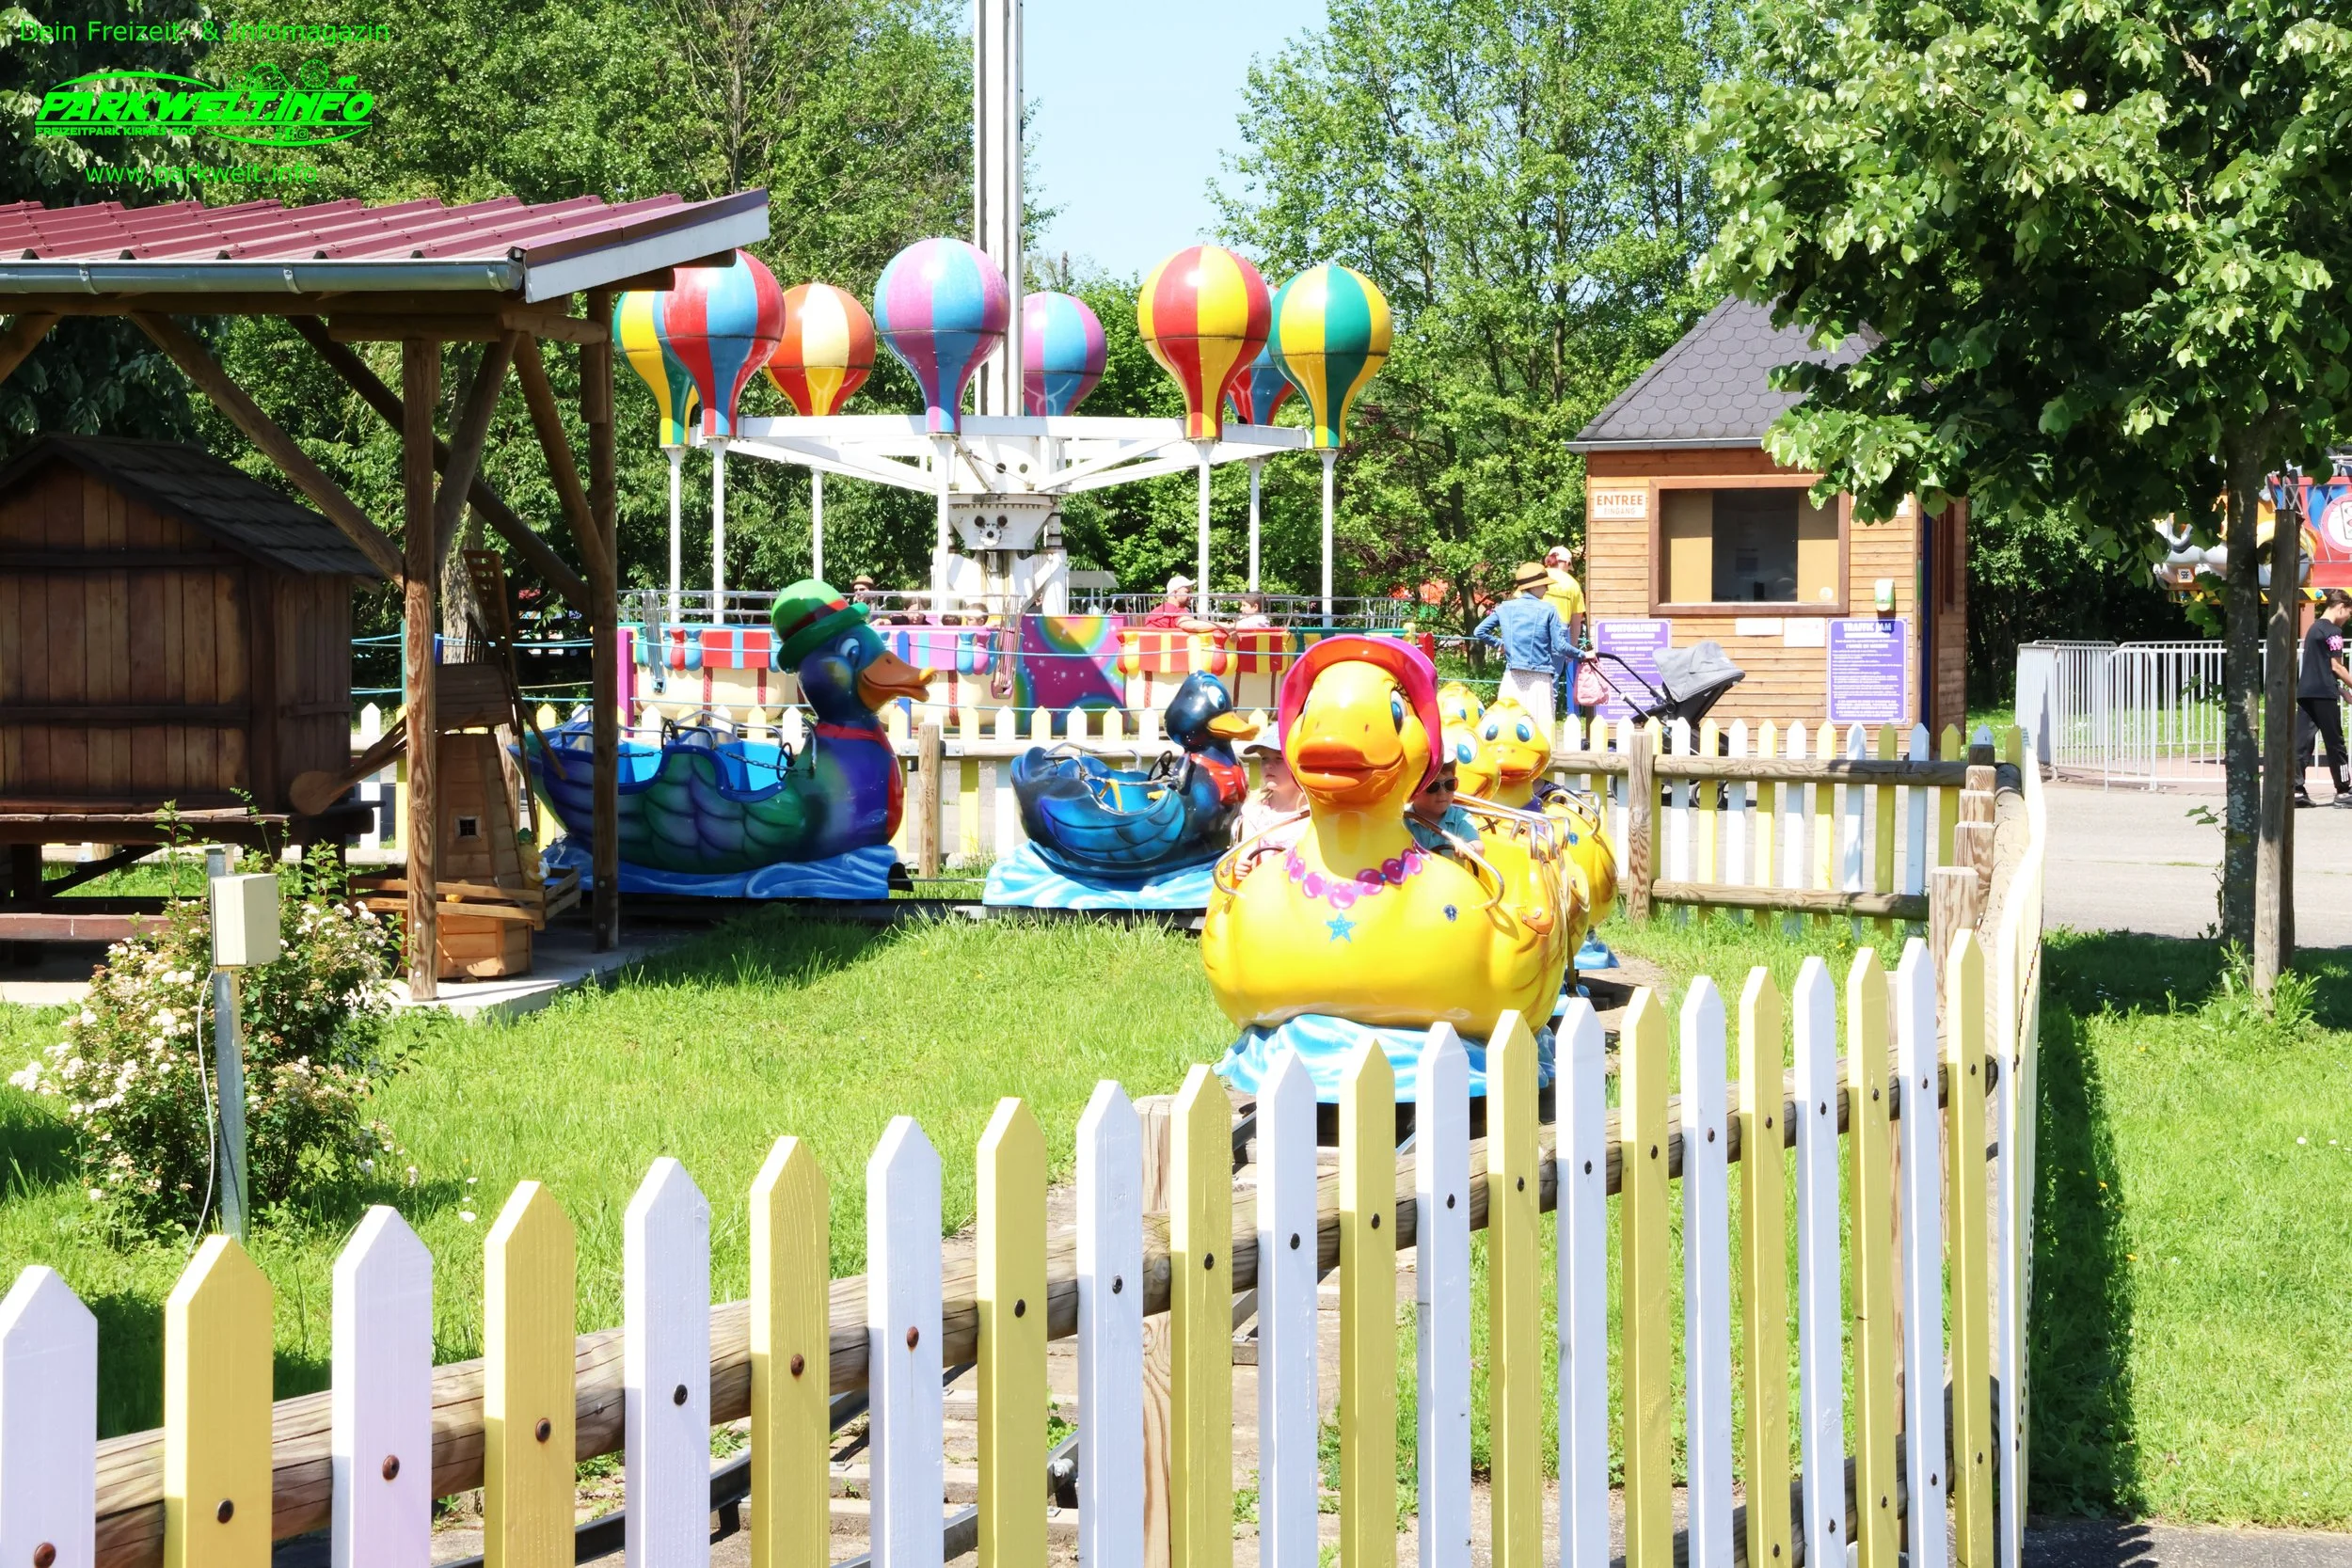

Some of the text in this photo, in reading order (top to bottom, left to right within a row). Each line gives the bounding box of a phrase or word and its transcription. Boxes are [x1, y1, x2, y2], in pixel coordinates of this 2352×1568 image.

[1597, 495, 1644, 506] ENTREE
[1603, 507, 1636, 515] EINGANG
[1842, 622, 1892, 633] TRAFFIC JAM
